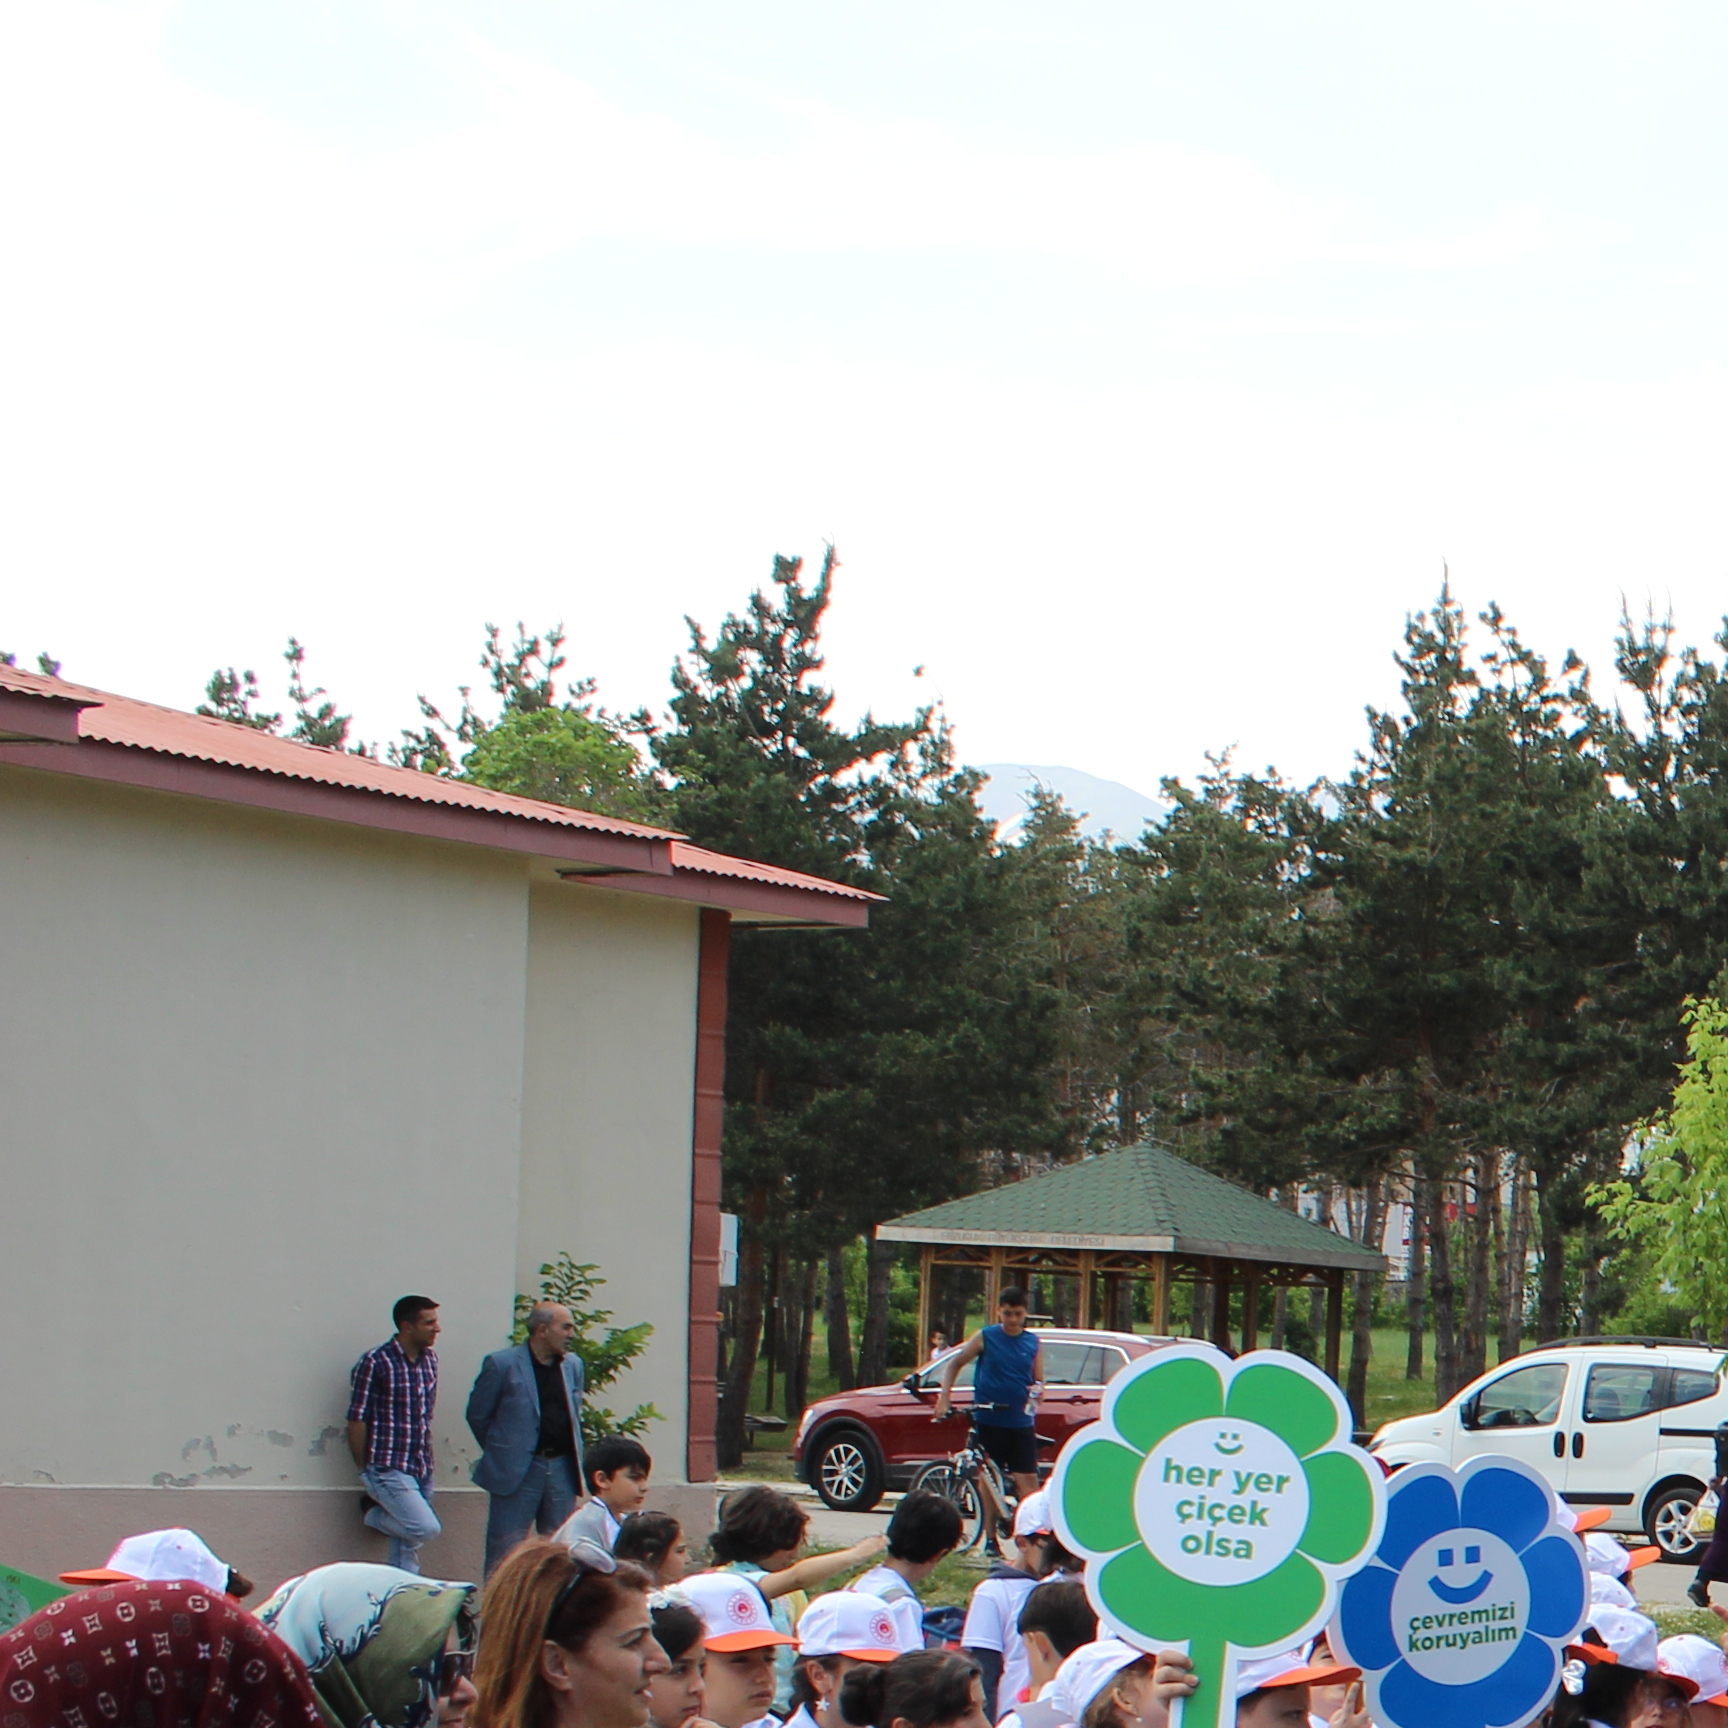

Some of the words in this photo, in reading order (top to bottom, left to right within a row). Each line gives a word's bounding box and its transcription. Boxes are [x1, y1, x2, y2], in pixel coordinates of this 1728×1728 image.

[1162, 1457, 1223, 1488] her
[1231, 1469, 1291, 1496] yer
[1175, 1494, 1271, 1528] çiçek
[1180, 1530, 1255, 1560] olsa
[1409, 1601, 1516, 1634] çevremizi
[1408, 1625, 1517, 1652] koruyalım
